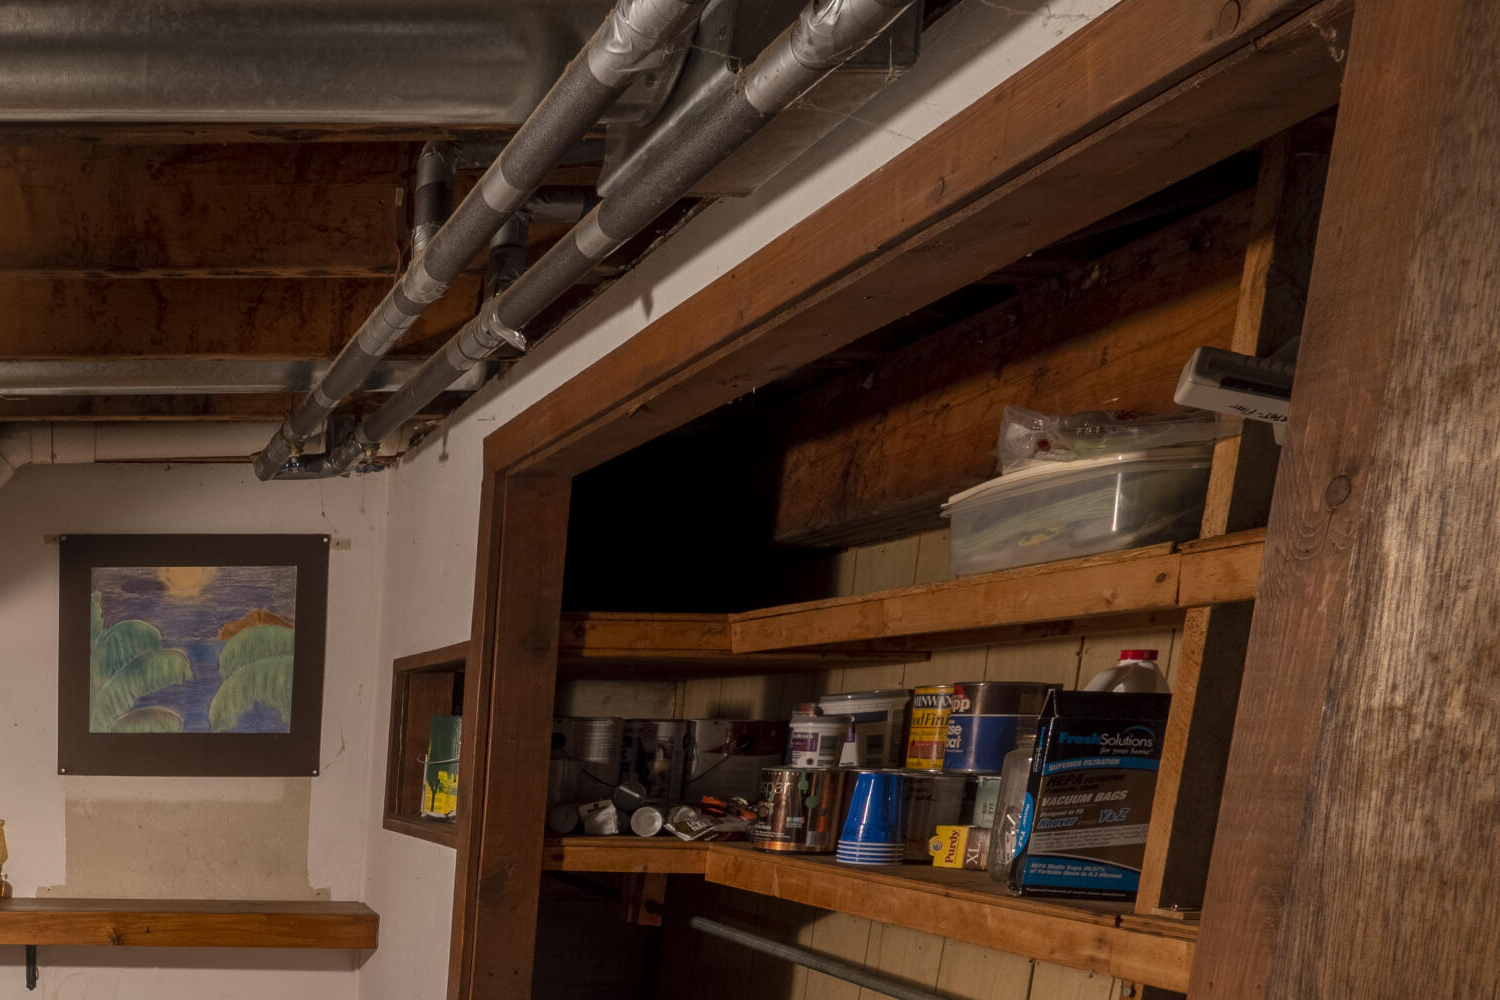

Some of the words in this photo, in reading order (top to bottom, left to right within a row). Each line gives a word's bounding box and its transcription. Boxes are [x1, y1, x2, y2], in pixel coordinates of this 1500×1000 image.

[1048, 761, 1082, 771] SUPERIOR
[1083, 759, 1120, 768] FILTRATION
[1047, 774, 1083, 787] HEPA
[1041, 794, 1092, 807] VACUUM
[1094, 790, 1129, 802] BAGS
[1037, 817, 1078, 830] Hoover
[945, 830, 961, 864] Purdy
[966, 842, 981, 865] XL
